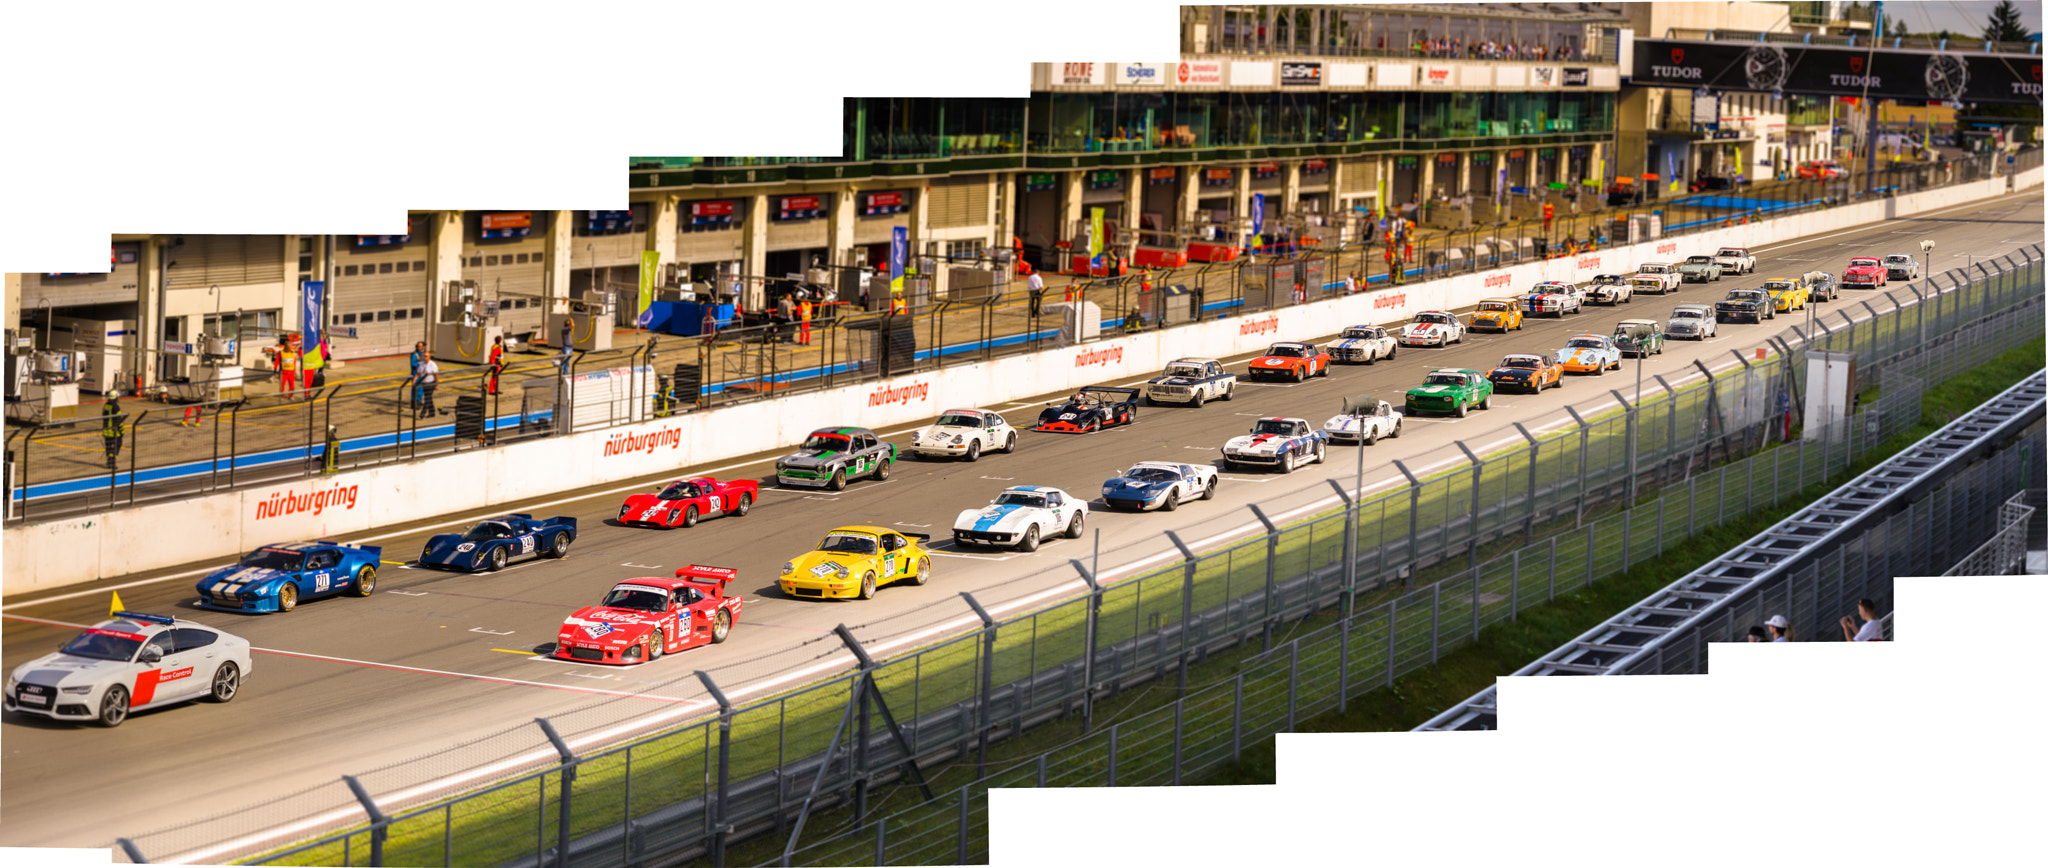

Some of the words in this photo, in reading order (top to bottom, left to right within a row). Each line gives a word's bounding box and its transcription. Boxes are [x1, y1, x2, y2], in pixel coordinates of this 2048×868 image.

[1064, 63, 1092, 77] ROWE
[1652, 65, 1702, 79] TUDOR
[1830, 74, 1881, 88] TUDOR
[1373, 293, 1407, 310] nürburgring
[350, 327, 356, 336] 2
[1239, 315, 1279, 336] nürburgring
[1075, 345, 1124, 368] nürburgring
[869, 379, 929, 407] nürburgring
[604, 425, 682, 457] nürburgring
[256, 483, 358, 521] nürburgring
[522, 537, 533, 548] 240
[886, 560, 894, 572] 270
[316, 574, 328, 588] 271
[590, 623, 609, 636] 280
[680, 617, 690, 632] 280
[159, 673, 171, 681] Race
[172, 669, 192, 678] Control
